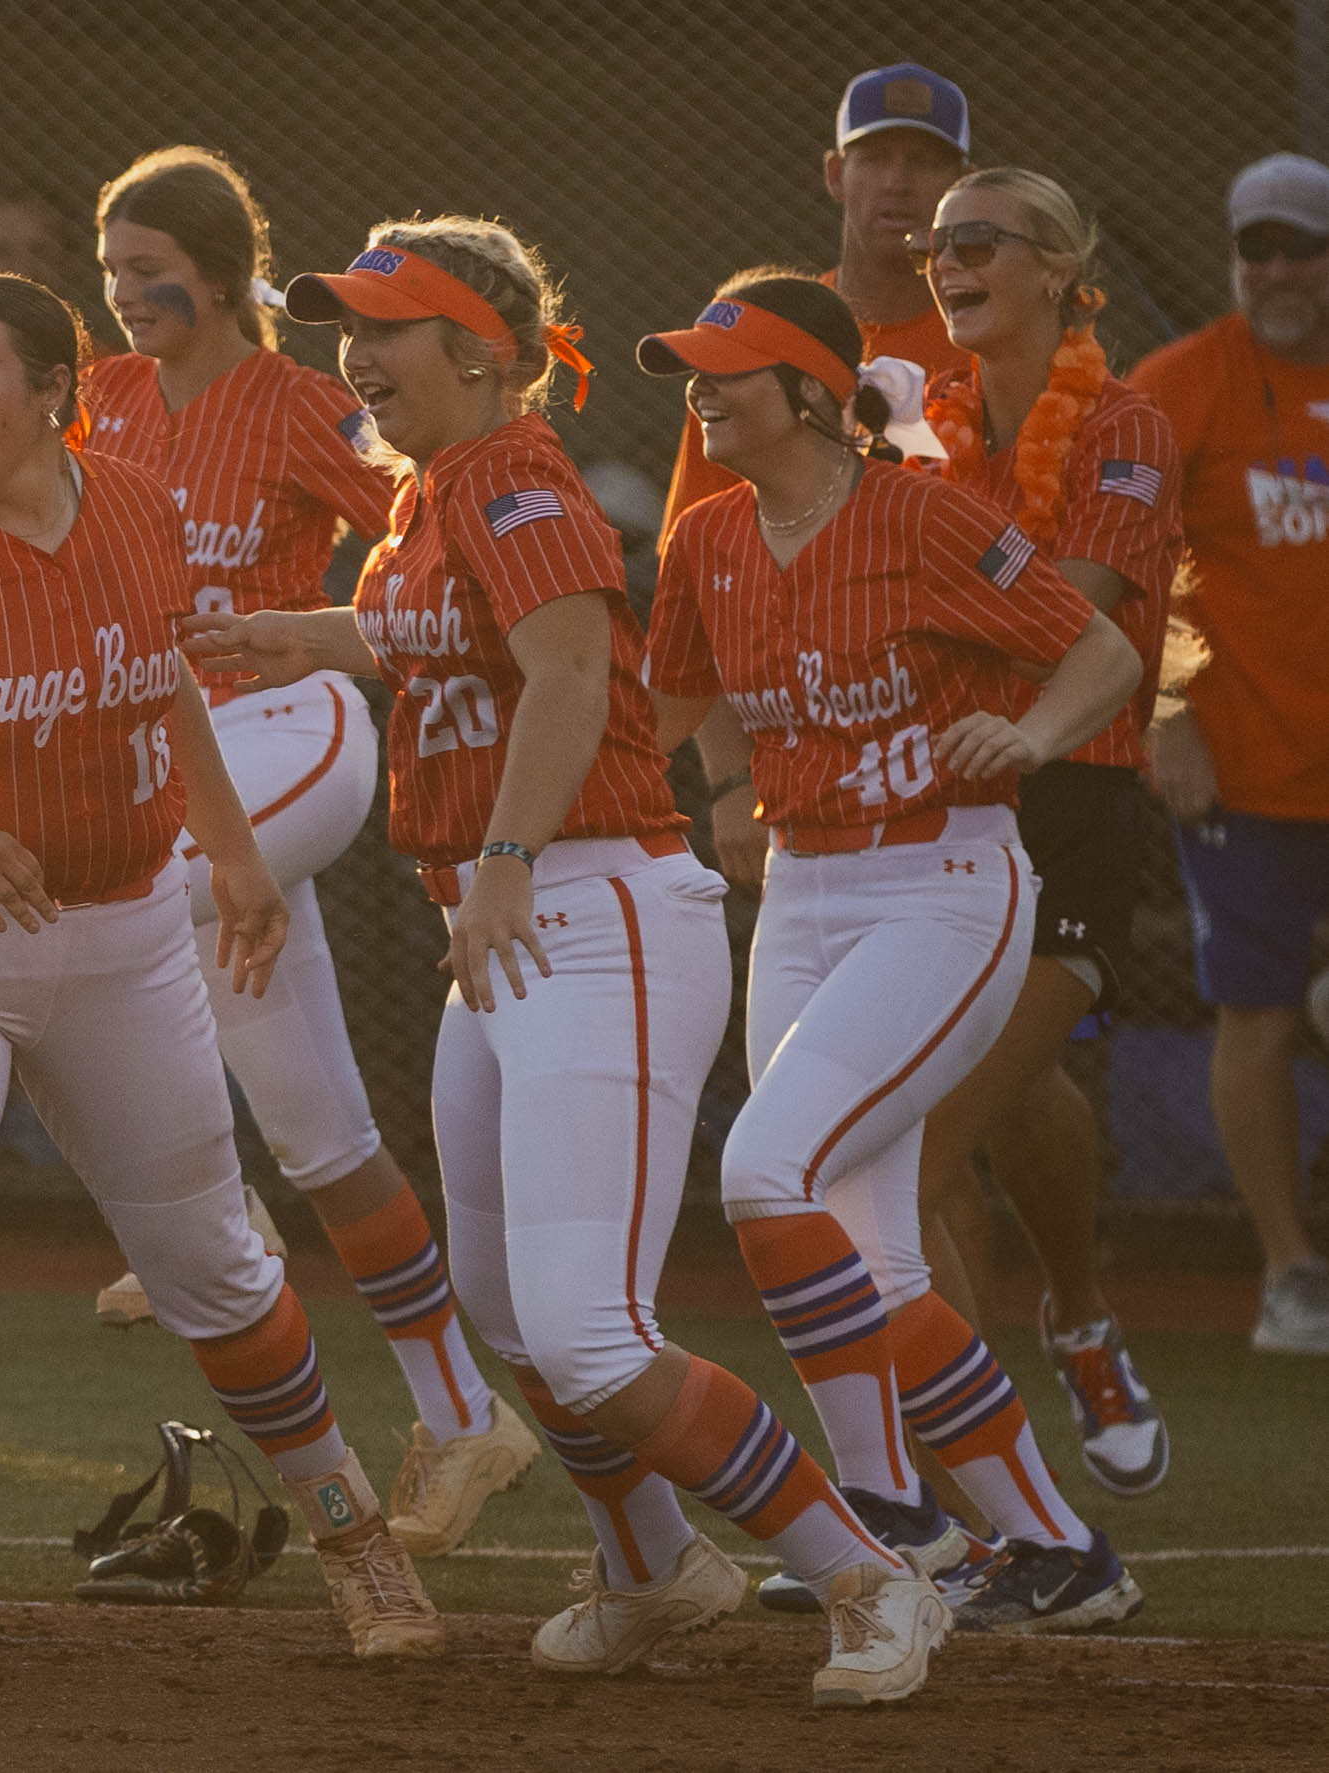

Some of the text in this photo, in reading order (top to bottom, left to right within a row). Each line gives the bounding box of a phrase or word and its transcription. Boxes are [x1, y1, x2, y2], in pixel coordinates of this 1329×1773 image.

[94, 623, 181, 709] Beac
[796, 642, 918, 728] Beach
[127, 714, 171, 805] 18
[407, 674, 500, 759] 20
[838, 723, 935, 807] 40
